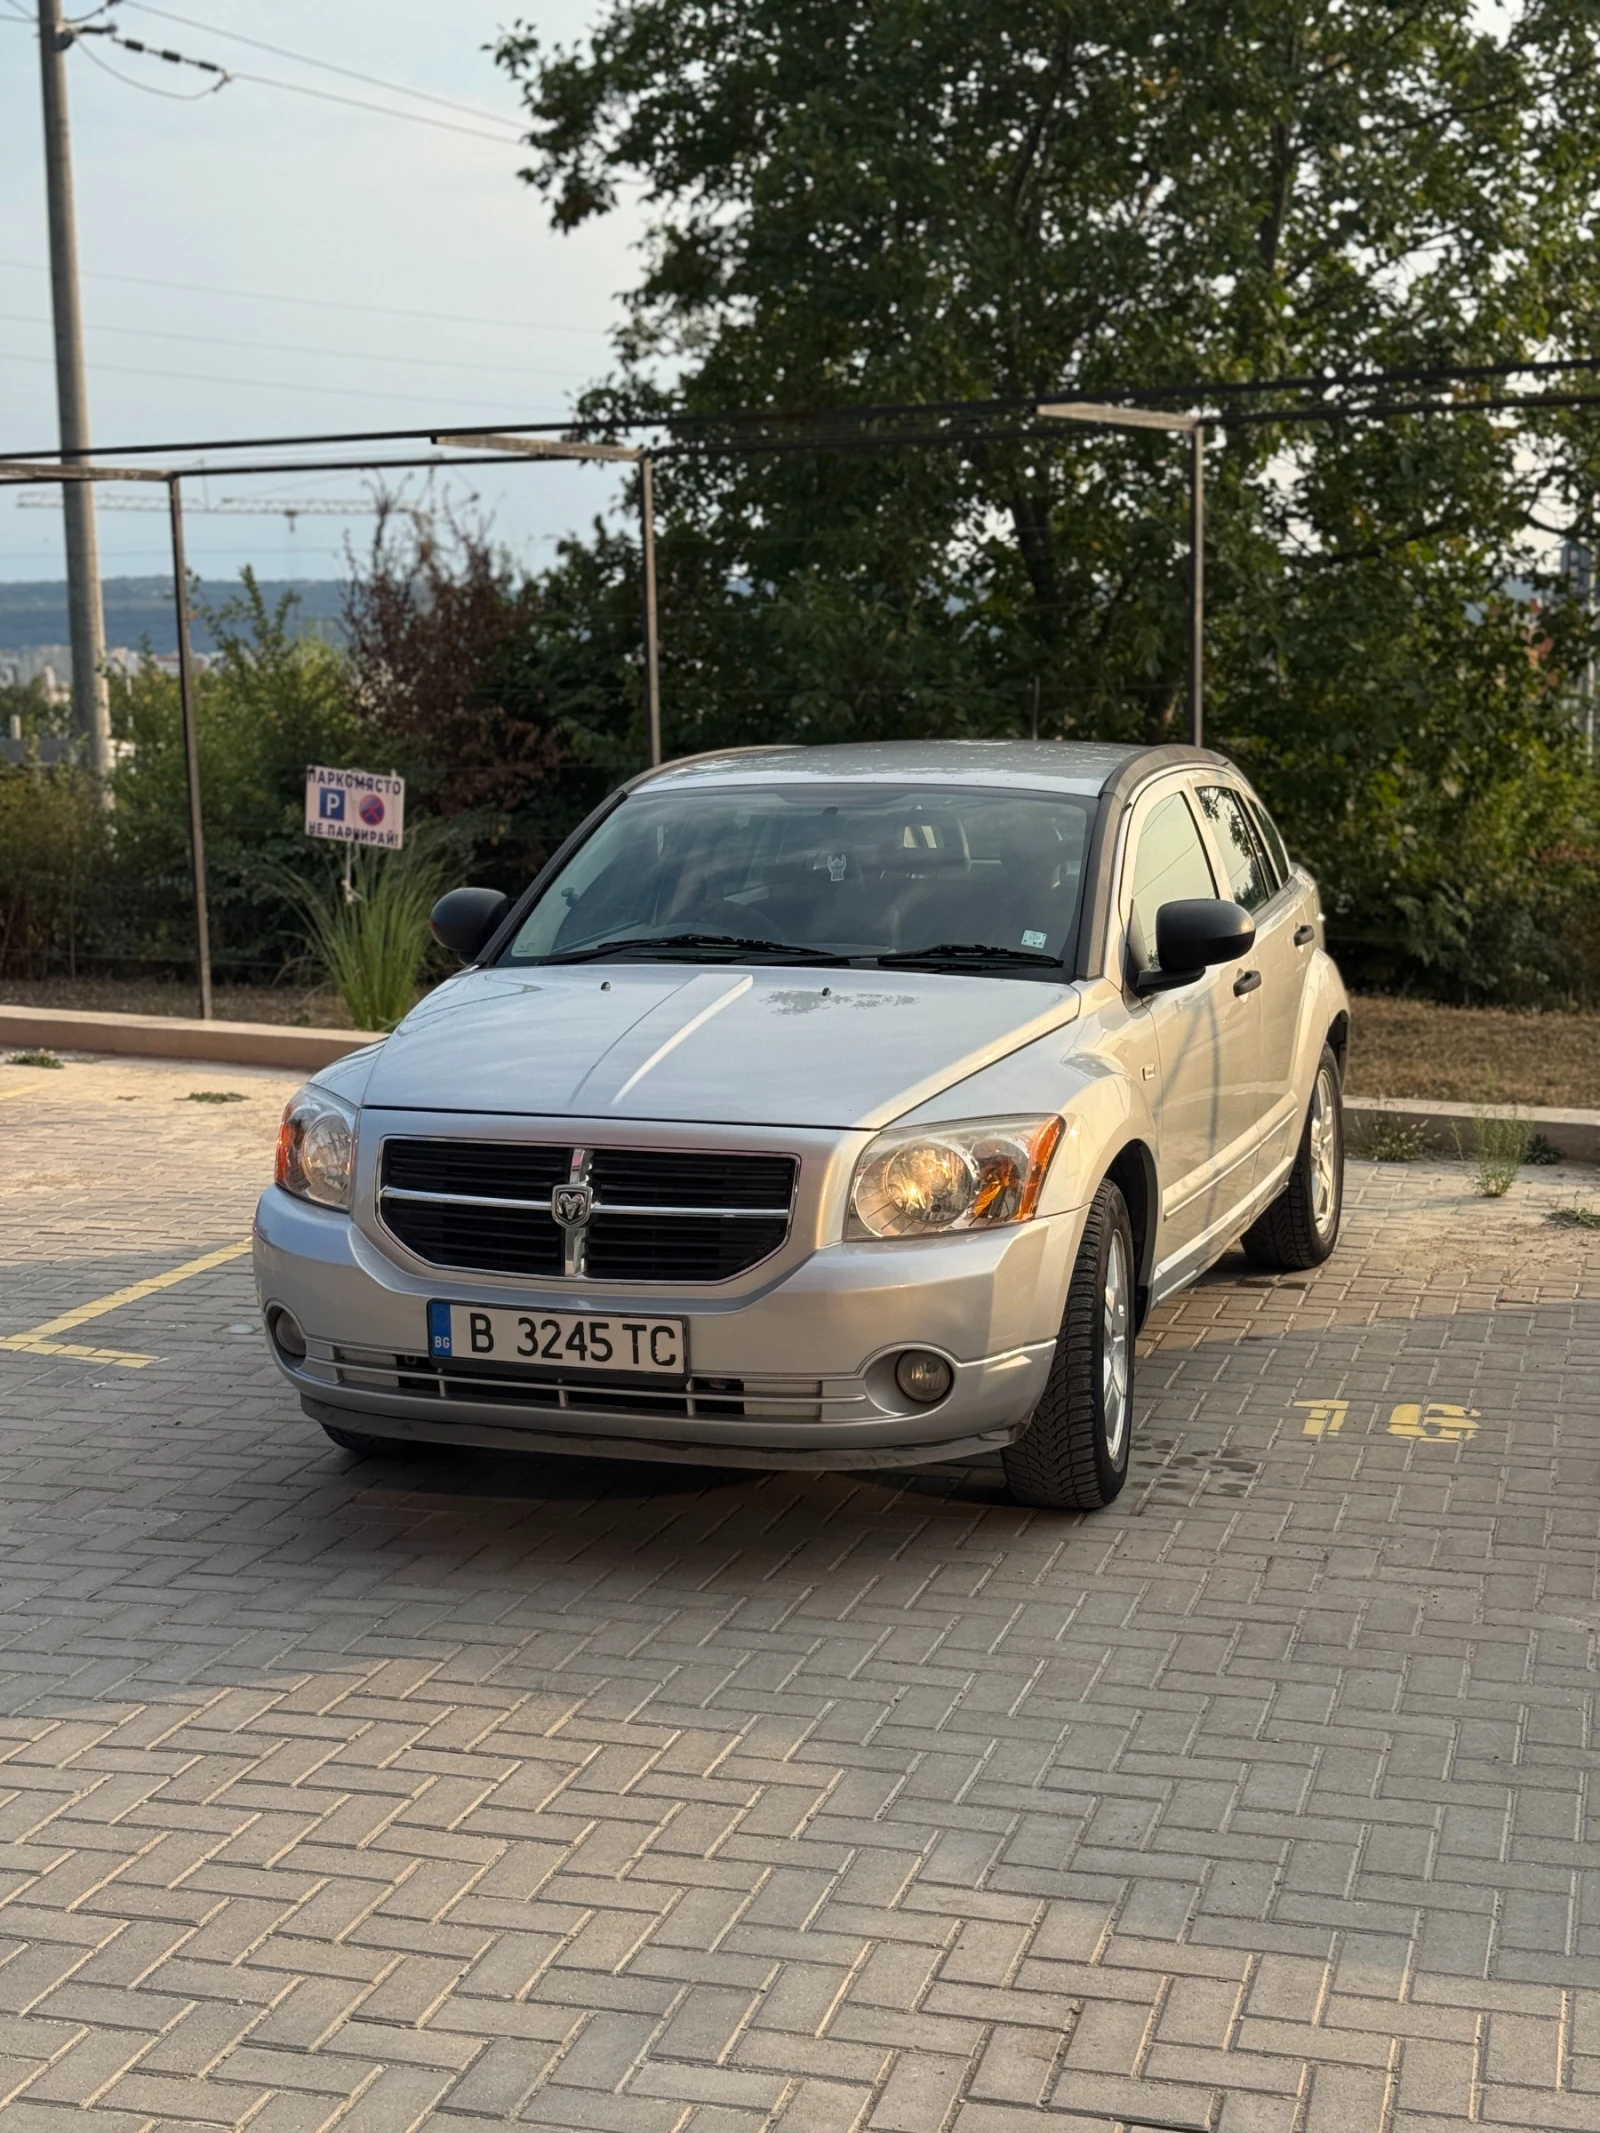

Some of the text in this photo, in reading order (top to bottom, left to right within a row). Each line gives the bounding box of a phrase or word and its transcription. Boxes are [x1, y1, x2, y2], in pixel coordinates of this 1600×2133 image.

[308, 768, 402, 796] ПАРКОМЯСТО
[326, 793, 341, 816] P
[308, 821, 323, 834] НЕ
[434, 1336, 451, 1349] BG
[469, 1312, 676, 1367] B 3245 TC
